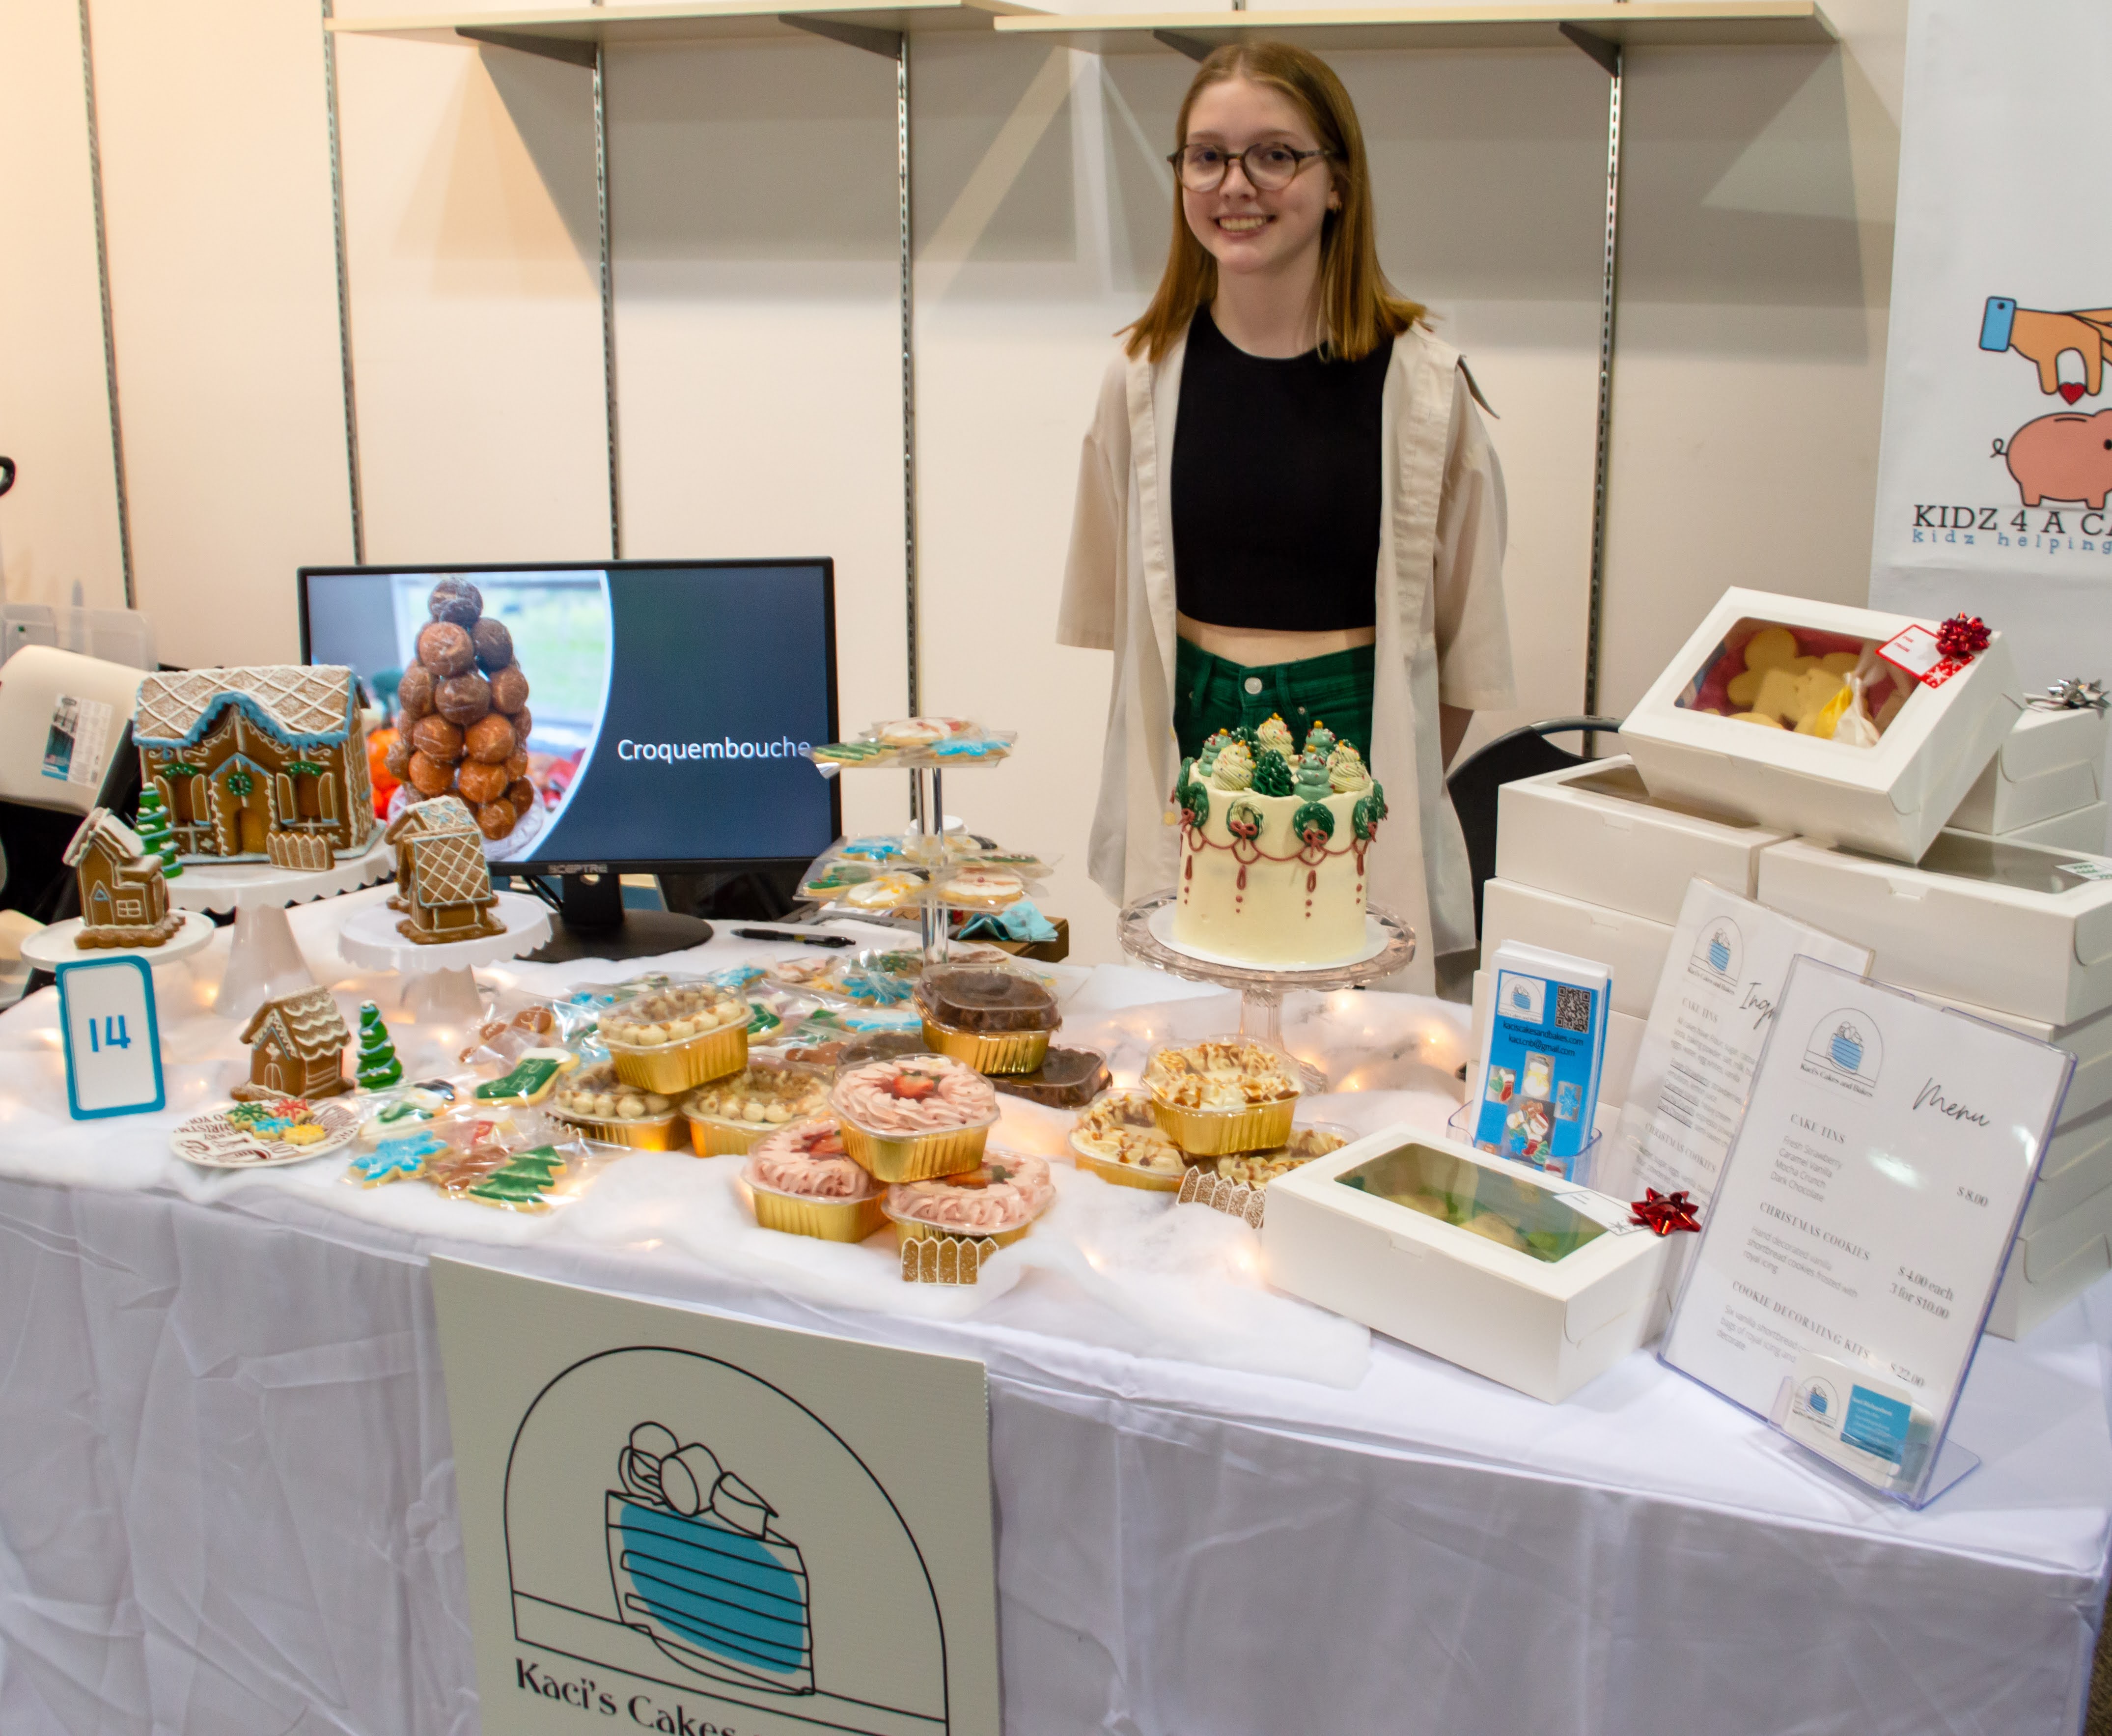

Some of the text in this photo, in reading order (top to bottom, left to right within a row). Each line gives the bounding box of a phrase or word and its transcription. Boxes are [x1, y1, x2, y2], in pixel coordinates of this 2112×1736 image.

[1914, 504, 2112, 536] KIDZ 4 A C
[1912, 529, 2112, 555] kidz helping
[617, 736, 811, 764] Croquembouche
[89, 1015, 131, 1052] 14
[1912, 1077, 1991, 1127] Menu
[1790, 1114, 1846, 1145] CAKE TINS
[1760, 1202, 1870, 1261] CHRISTMAS COOKIES
[1898, 1285, 1915, 1303] for
[1928, 1281, 1954, 1302] each
[1732, 1280, 1870, 1360] COOKIE DECORATING KITS
[516, 1657, 617, 1716] Kaci's
